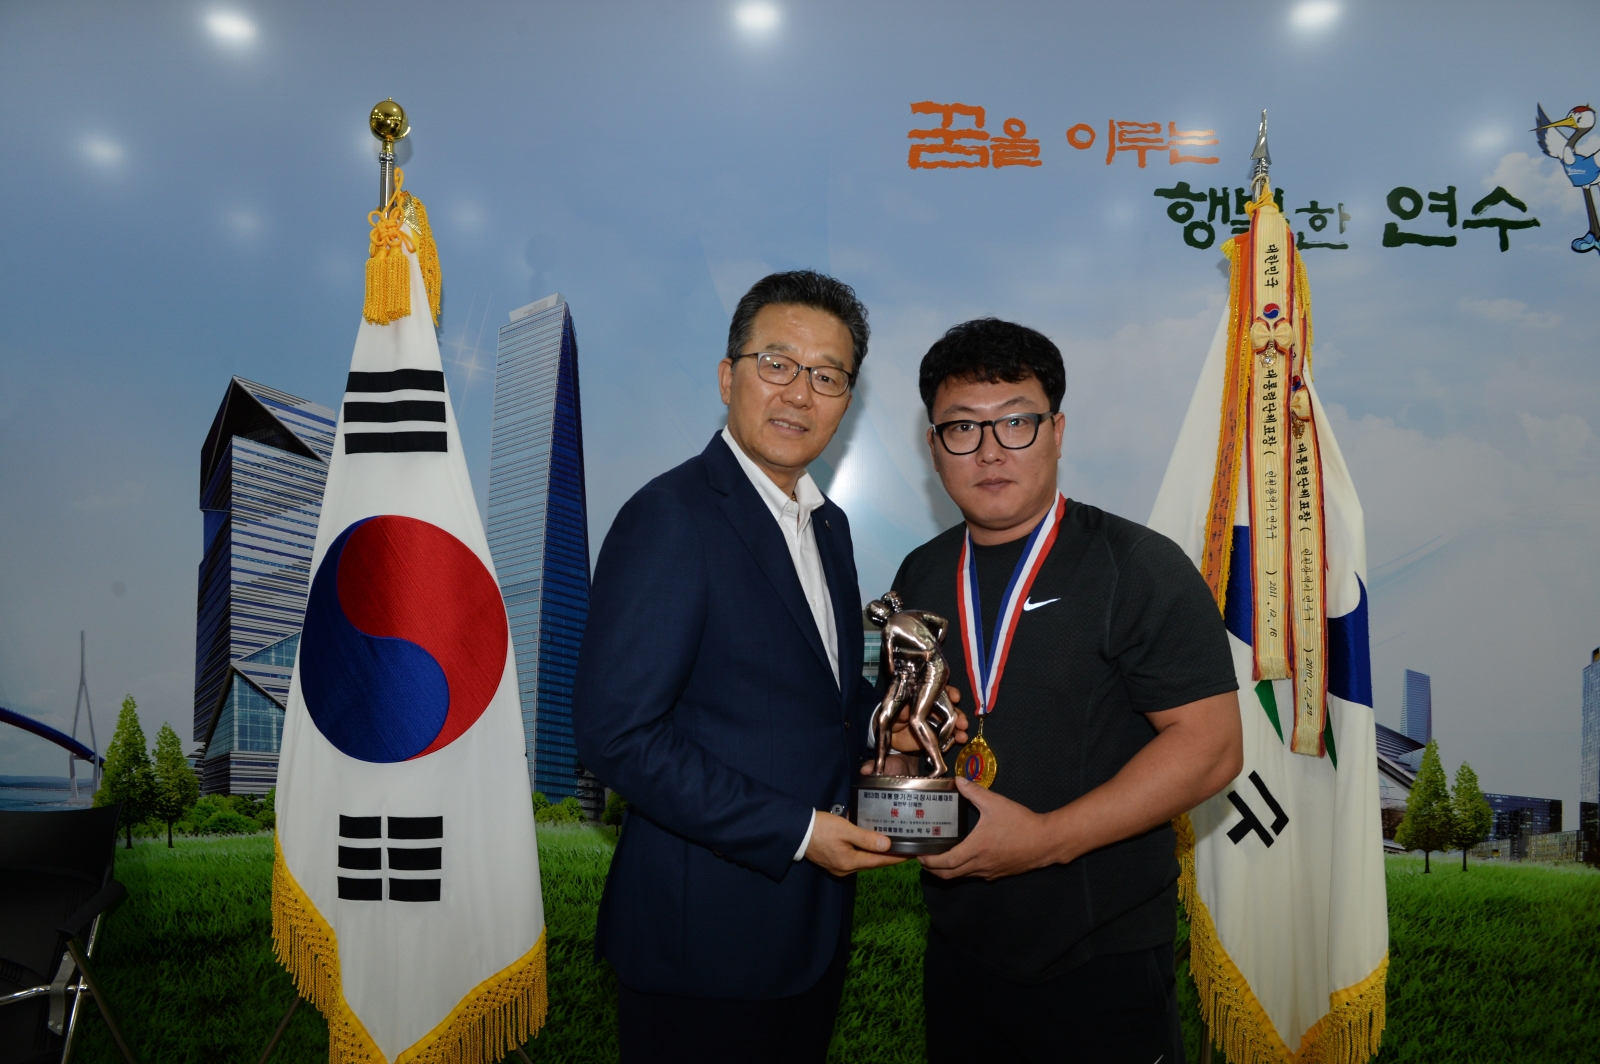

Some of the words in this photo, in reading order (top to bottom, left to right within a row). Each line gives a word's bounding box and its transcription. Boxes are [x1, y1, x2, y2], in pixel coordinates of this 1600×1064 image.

[908, 101, 1042, 169] 꿈을
[1066, 119, 1220, 169] 이루는
[1383, 186, 1541, 252] 연수
[1264, 243, 1280, 288] 대한민국
[1262, 368, 1278, 447] 대통령단체표창
[1264, 470, 1278, 512] 인천광역시
[1295, 443, 1312, 522] 대통령단체표창
[1265, 515, 1278, 540] 연수구
[863, 791, 880, 800] 제53회
